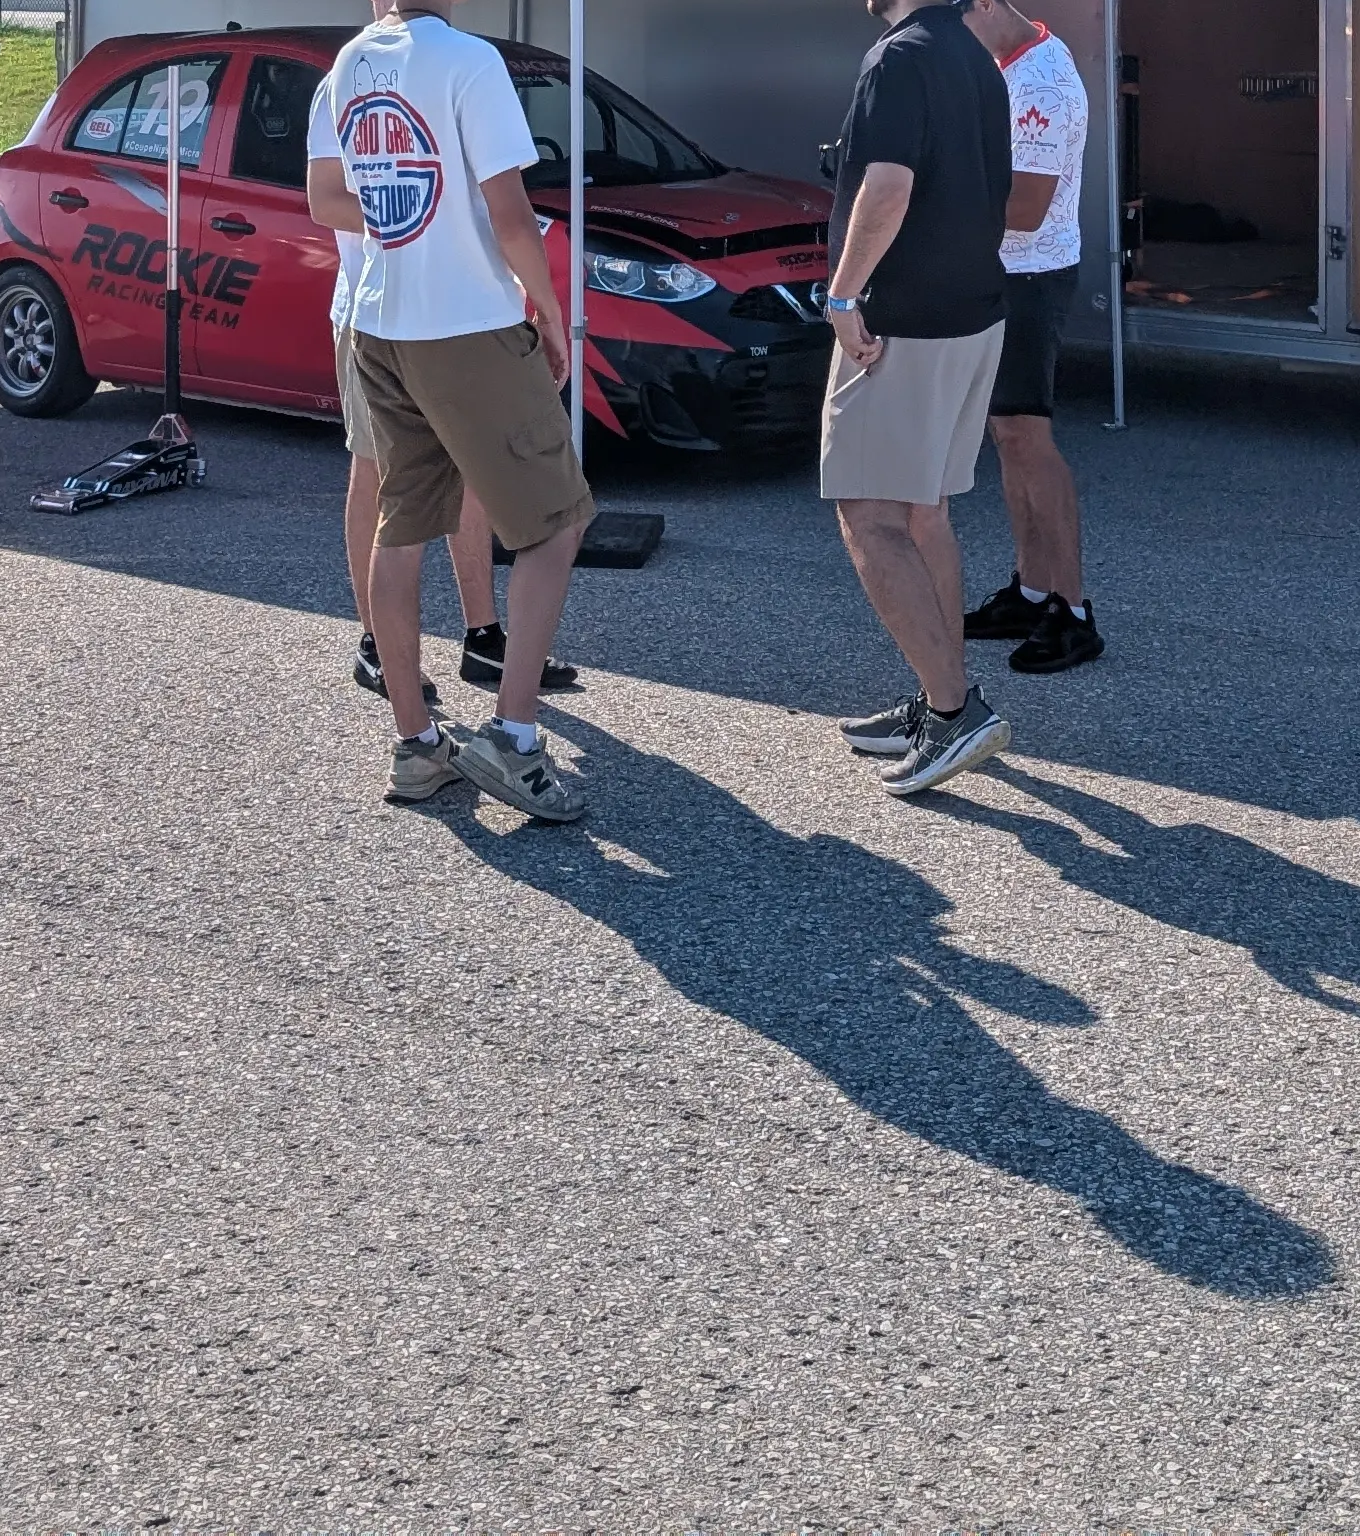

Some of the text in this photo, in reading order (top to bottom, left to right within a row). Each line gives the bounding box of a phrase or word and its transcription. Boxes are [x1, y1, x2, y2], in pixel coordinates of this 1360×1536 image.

[89, 121, 111, 133] BELL
[71, 223, 262, 307] ROOKIE
[750, 345, 769, 357] TOW
